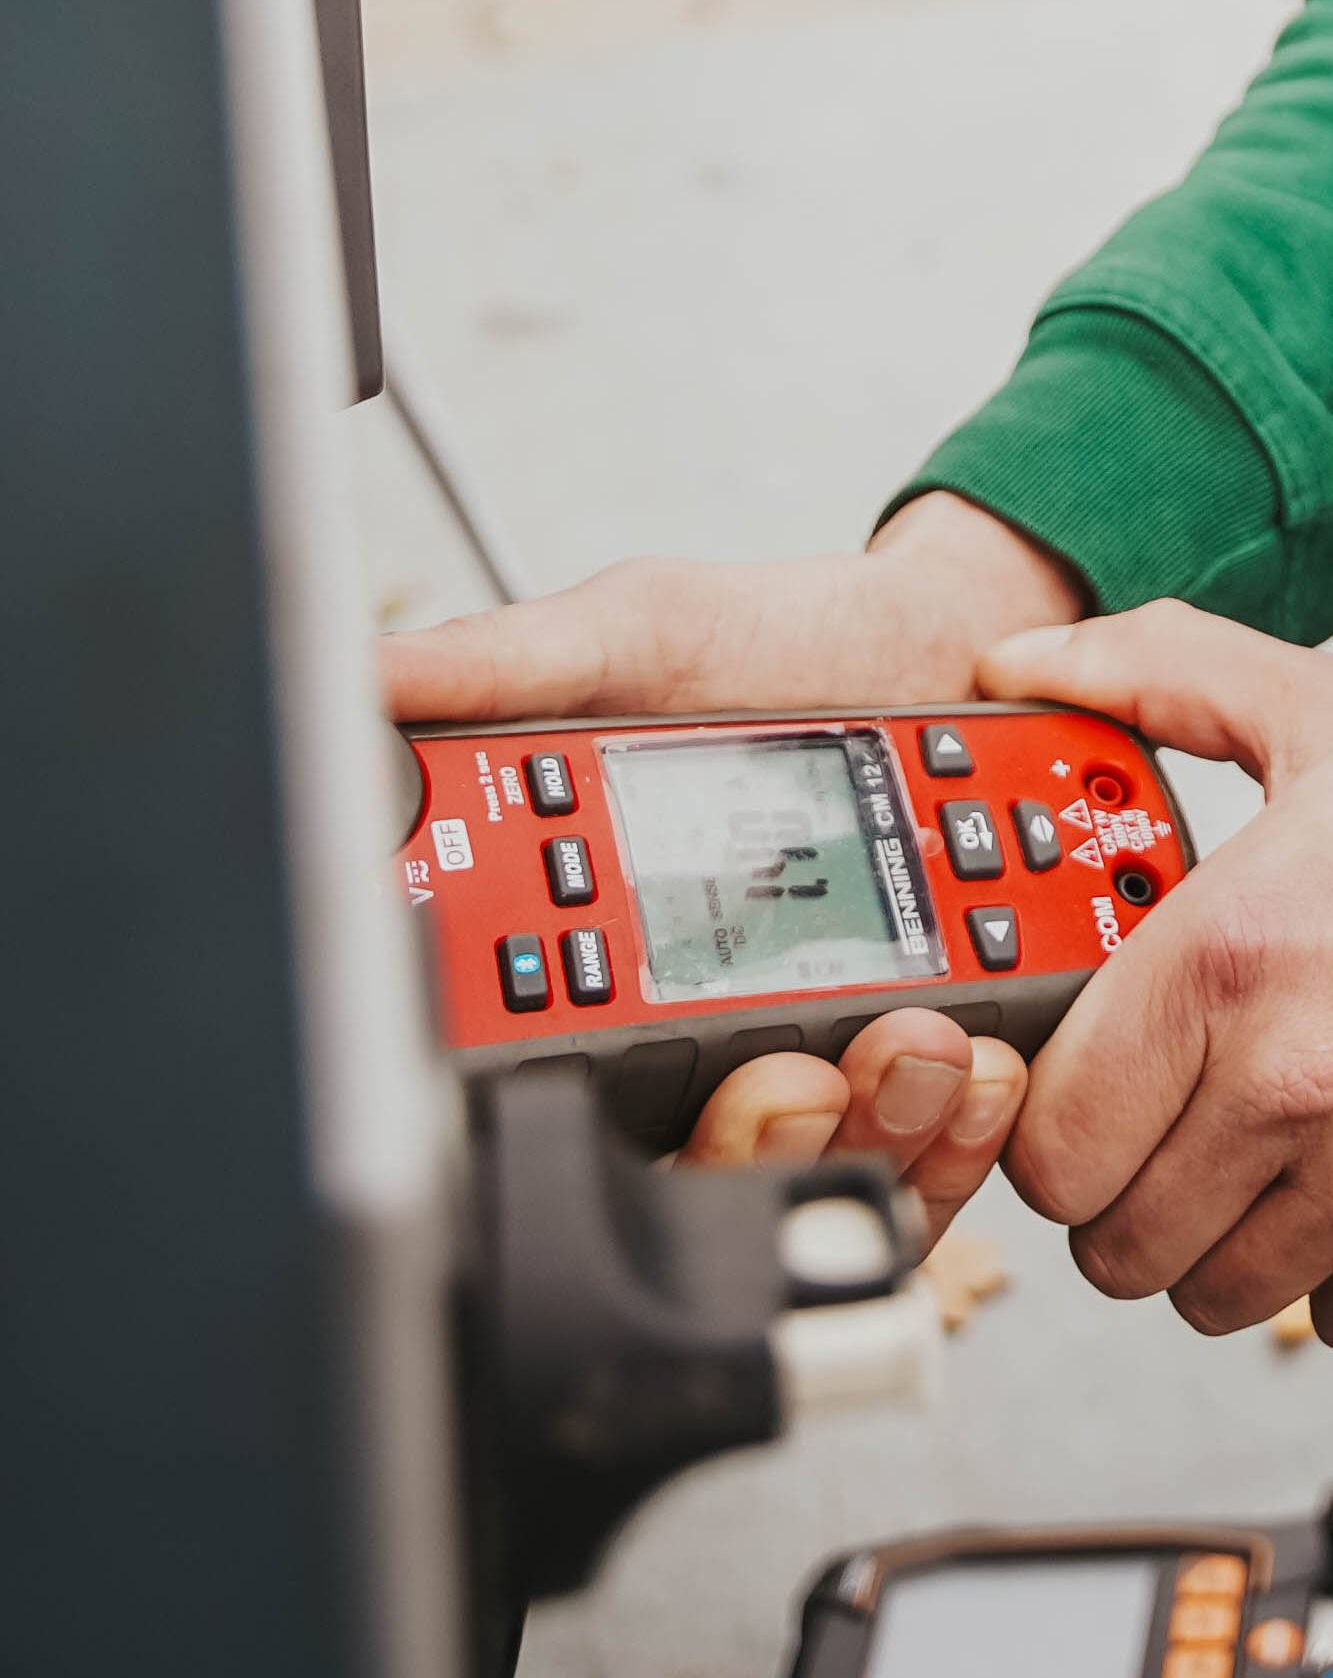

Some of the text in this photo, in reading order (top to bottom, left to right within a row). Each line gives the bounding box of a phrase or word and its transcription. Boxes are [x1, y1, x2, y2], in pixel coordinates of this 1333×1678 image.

[475, 751, 503, 822] Press 2 sec
[499, 766, 525, 805] ZERO
[540, 757, 566, 798] HOLD
[870, 793, 895, 826] CM
[440, 823, 465, 866] OFF
[956, 818, 980, 850] OK
[560, 842, 586, 889] MODE
[882, 838, 929, 955] BENNING
[1091, 896, 1123, 953] COM
[578, 930, 604, 989] RANGE
[714, 927, 734, 967] AUTO
